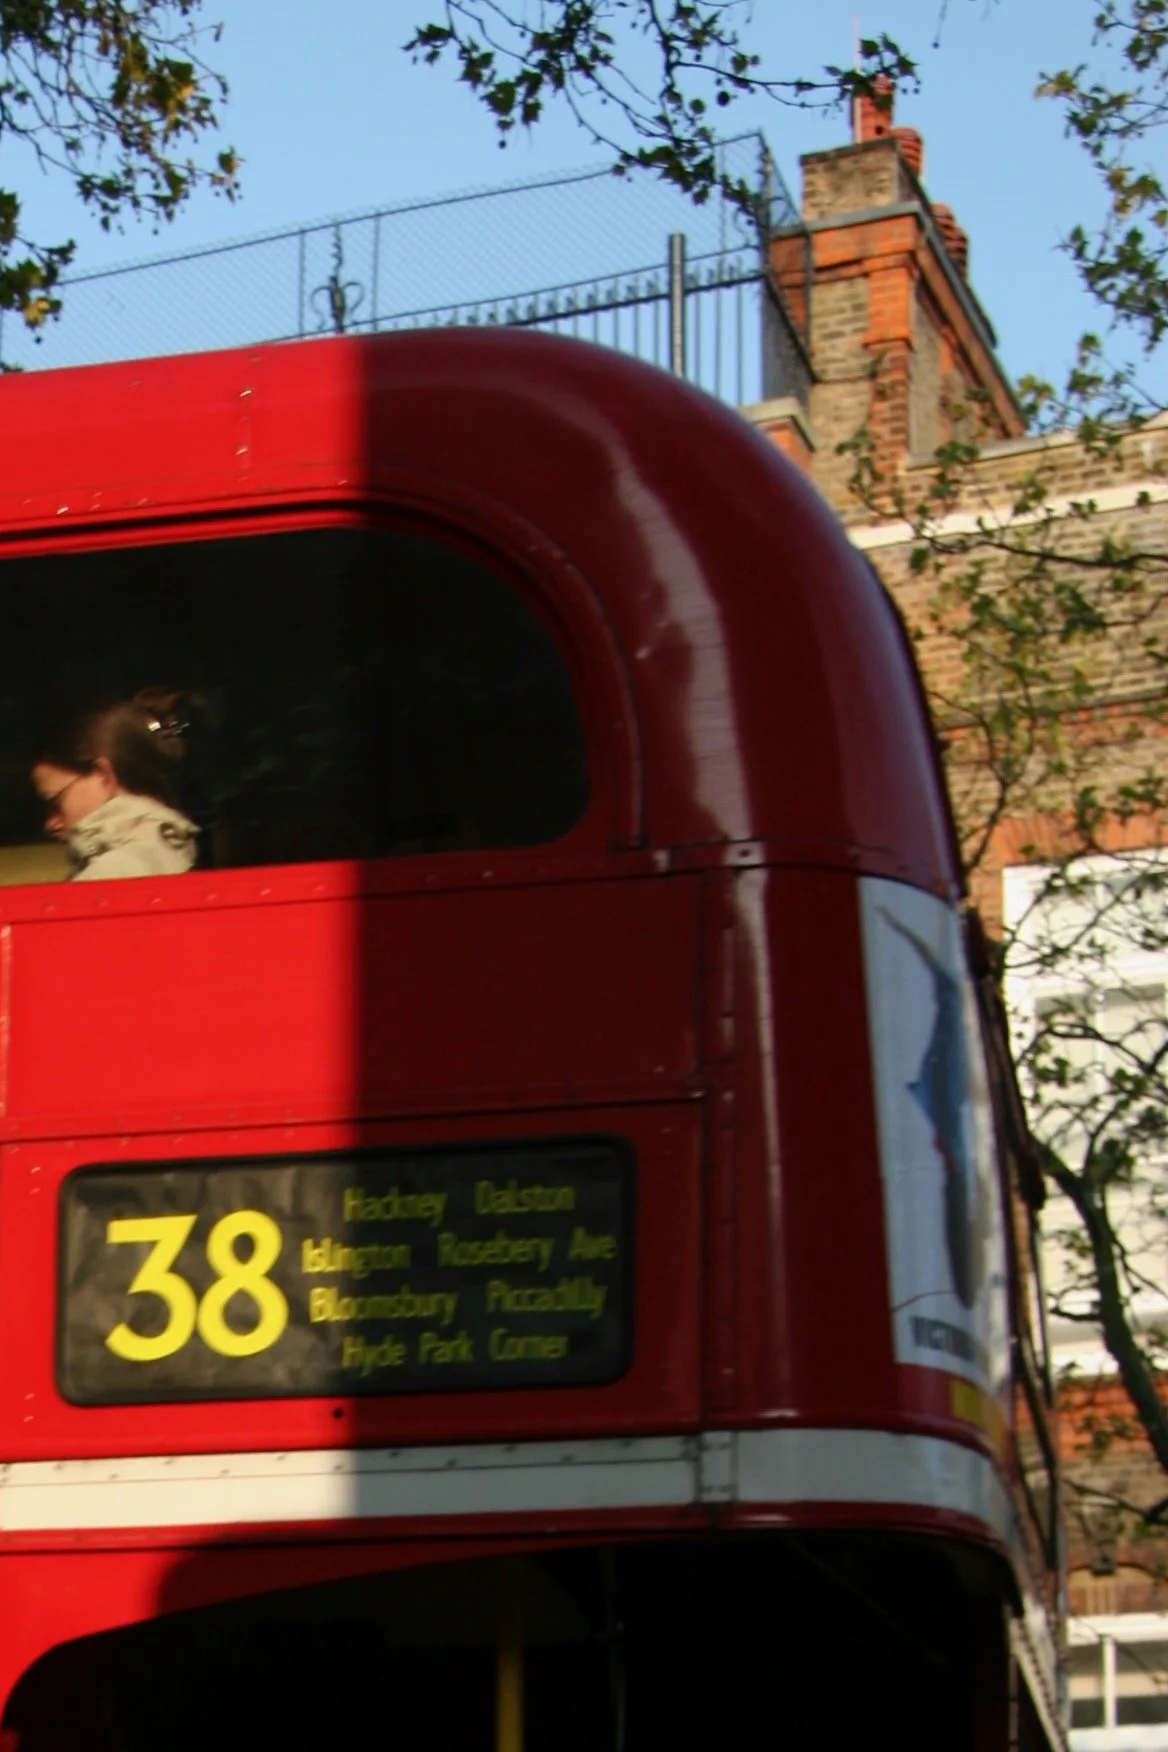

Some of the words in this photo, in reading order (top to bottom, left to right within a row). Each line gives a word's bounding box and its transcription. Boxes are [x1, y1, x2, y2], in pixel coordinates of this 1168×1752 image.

[343, 1187, 447, 1227] Hackney
[474, 1178, 576, 1214] Dalston
[301, 1237, 411, 1279] Islington
[437, 1229, 555, 1273] Rosebery
[568, 1226, 617, 1261] Ave
[104, 1209, 289, 1362] 38
[309, 1284, 457, 1326] Bloomsbury
[486, 1275, 608, 1320] Piccadilly
[342, 1334, 407, 1377] Hyde
[419, 1329, 474, 1365] Park
[488, 1327, 569, 1362] Corner
